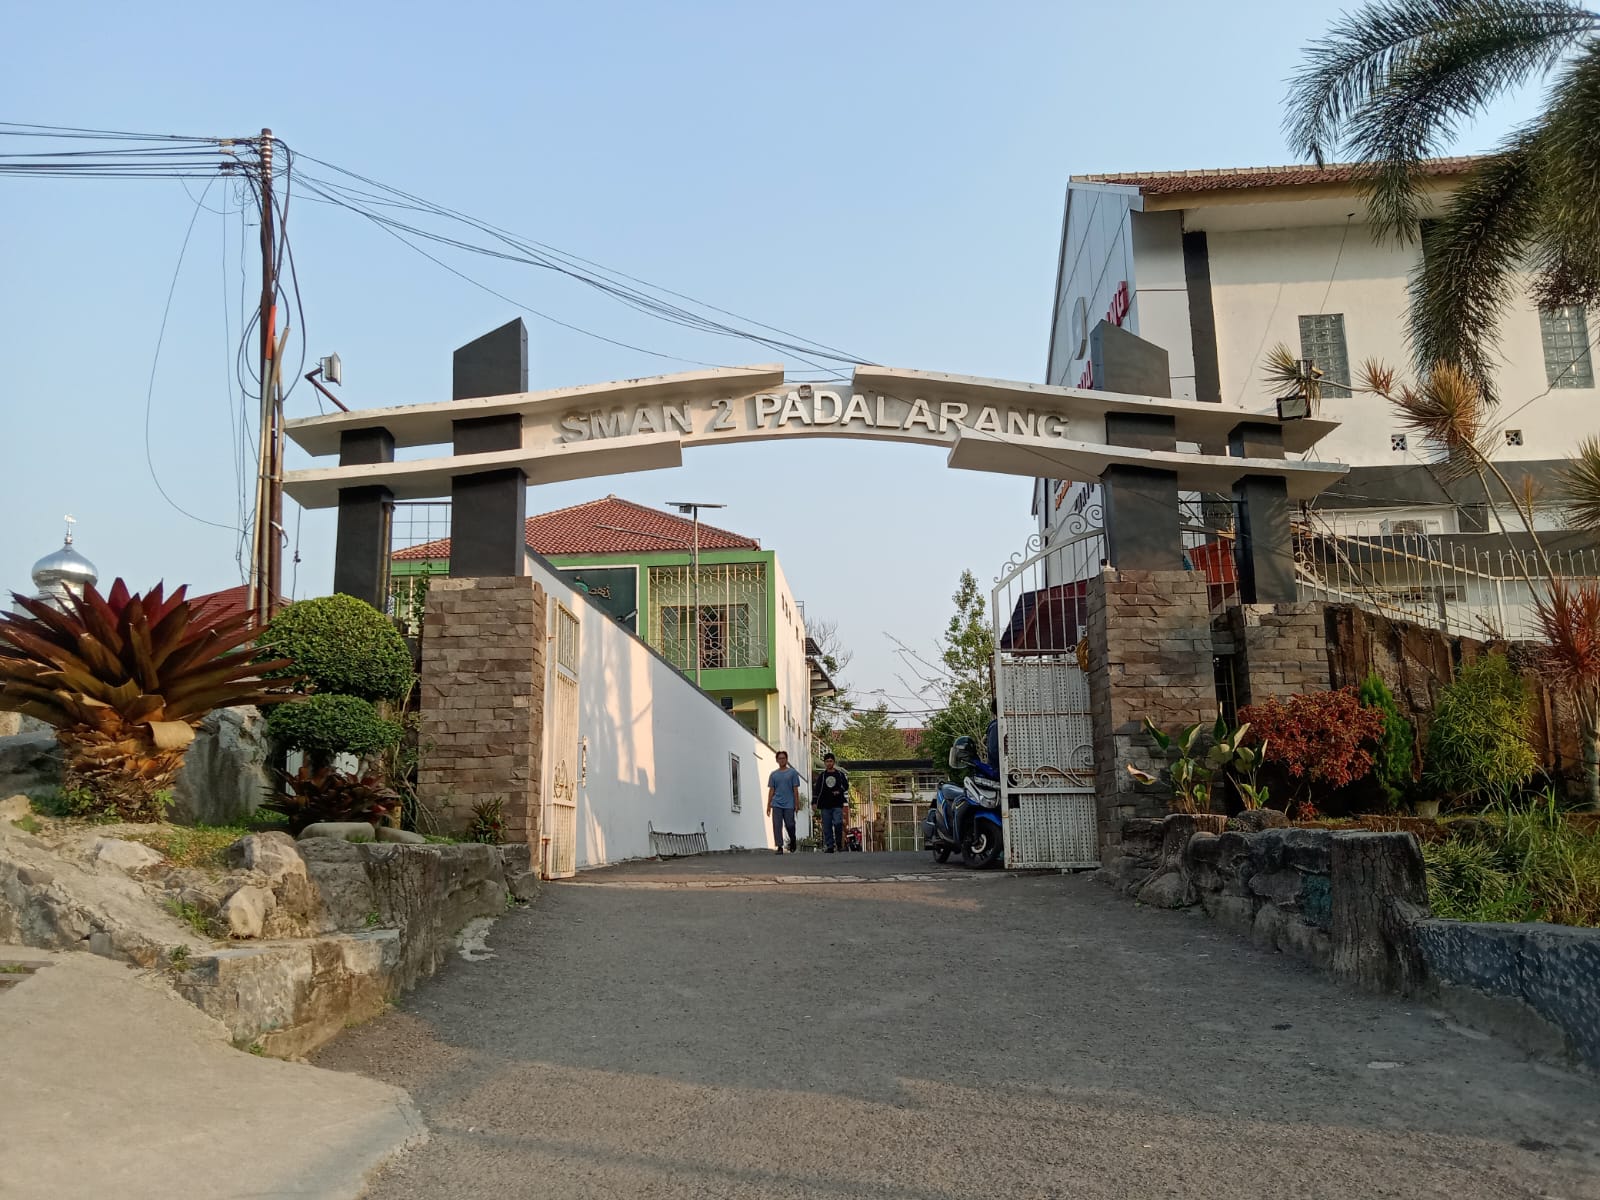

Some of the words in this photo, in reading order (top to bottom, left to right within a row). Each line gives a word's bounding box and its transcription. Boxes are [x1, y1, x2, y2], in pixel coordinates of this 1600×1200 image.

[561, 401, 693, 443] SMAN
[711, 399, 737, 430] 2
[754, 390, 1068, 440] PADALARANG
